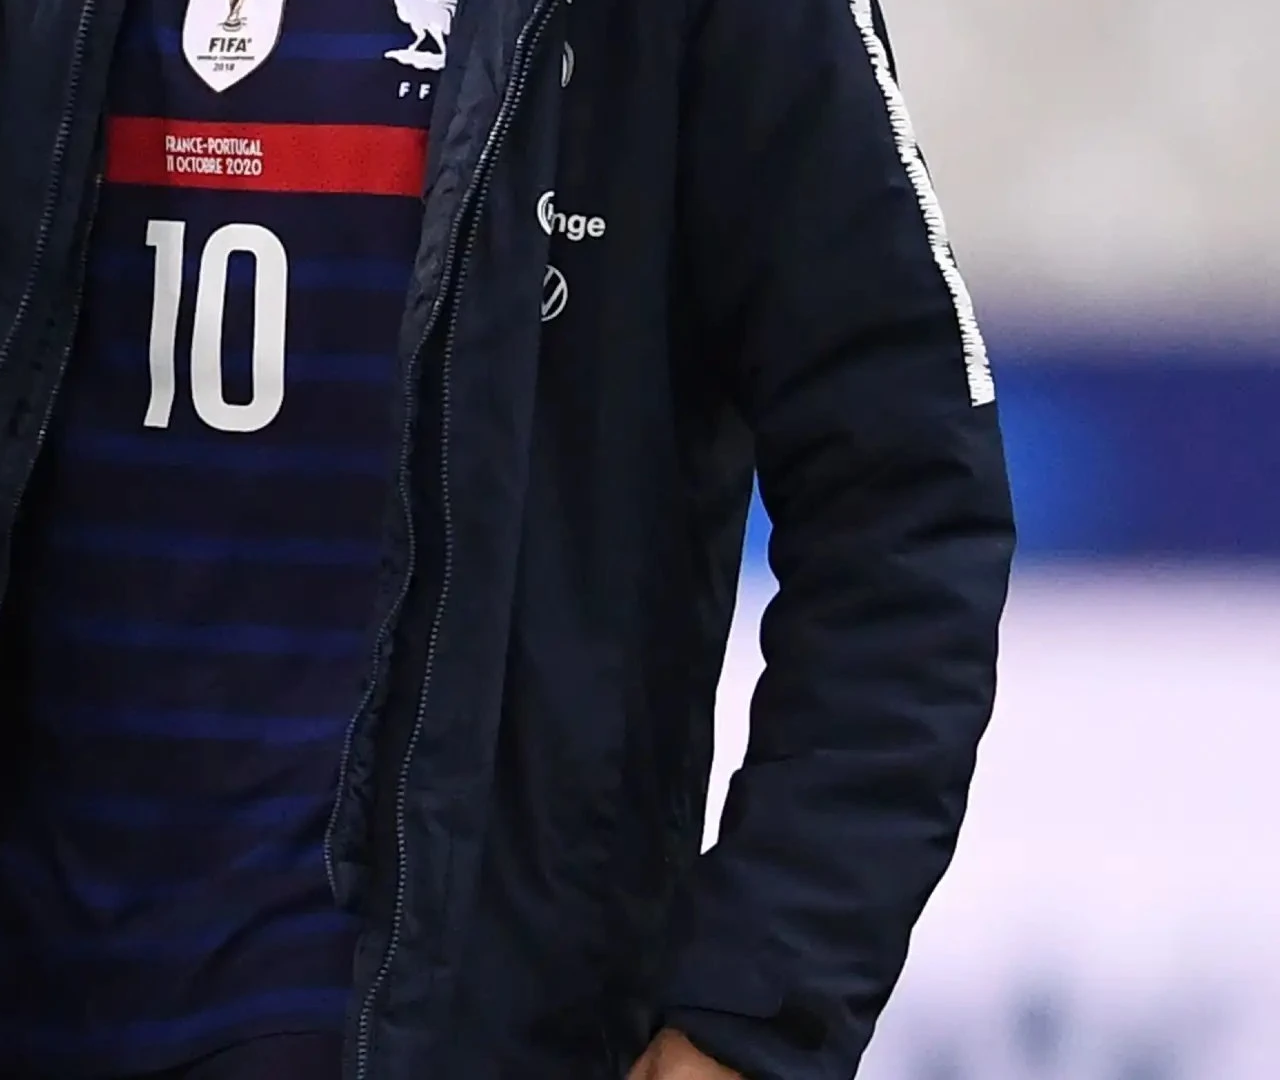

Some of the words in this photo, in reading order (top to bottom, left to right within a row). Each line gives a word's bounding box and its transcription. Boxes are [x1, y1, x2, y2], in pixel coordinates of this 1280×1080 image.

[209, 37, 247, 52] FIFA
[176, 157, 224, 174] OCTOBRE
[226, 158, 262, 176] 2020
[143, 219, 288, 432] 10
